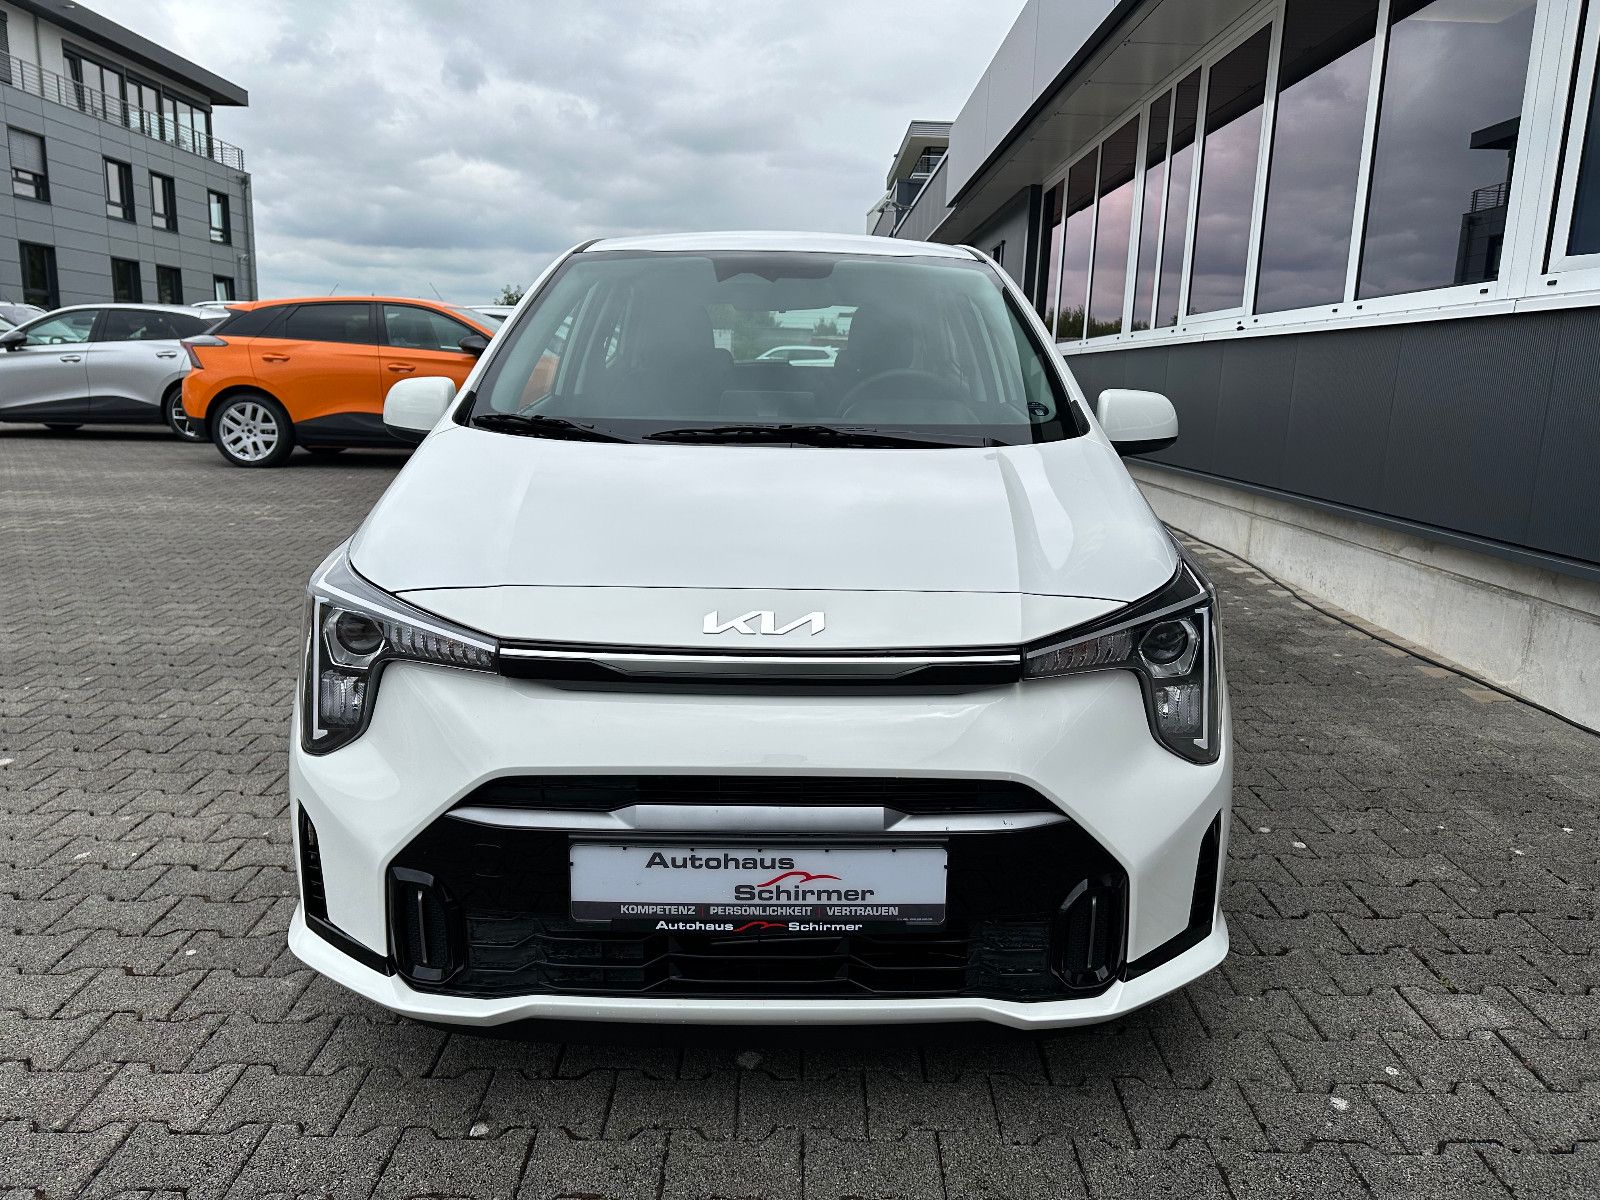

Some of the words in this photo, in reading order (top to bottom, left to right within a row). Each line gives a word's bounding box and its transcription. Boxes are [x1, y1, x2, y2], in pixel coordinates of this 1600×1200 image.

[703, 610, 825, 636] KIA
[645, 851, 795, 870] Autohaus
[734, 884, 875, 902] Schirmer
[620, 905, 696, 915] KOMPETENZ
[709, 905, 813, 916] PERSÖNLICHKEIT
[826, 906, 899, 916] VERTRAUEN
[655, 920, 734, 931] Autohaus
[788, 922, 863, 931] Schirmer
